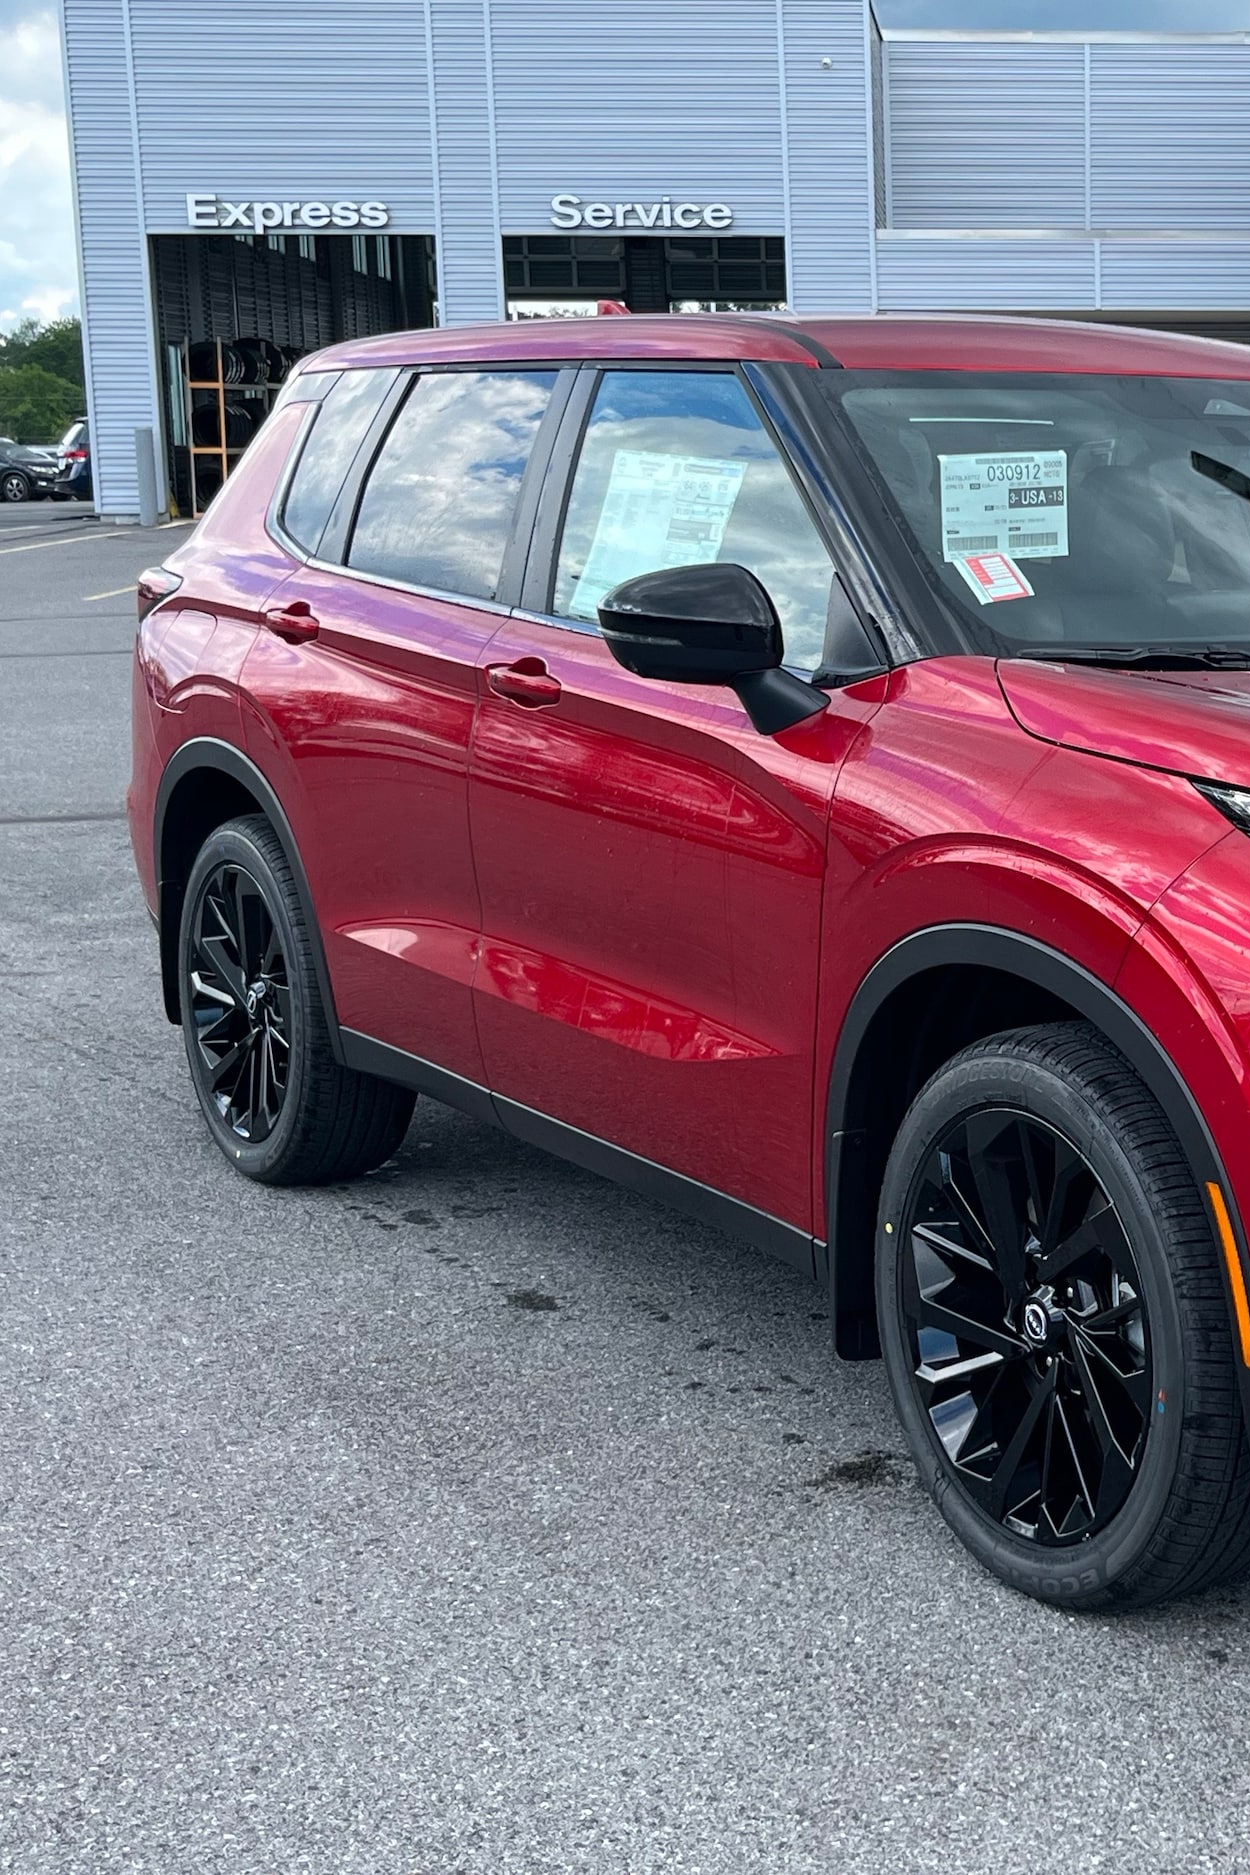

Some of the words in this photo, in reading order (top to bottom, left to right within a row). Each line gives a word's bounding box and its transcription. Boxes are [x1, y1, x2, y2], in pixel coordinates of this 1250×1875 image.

[186, 193, 390, 235] Express
[550, 194, 734, 230] Service
[987, 464, 1040, 482] 030912
[1021, 489, 1047, 505] USA
